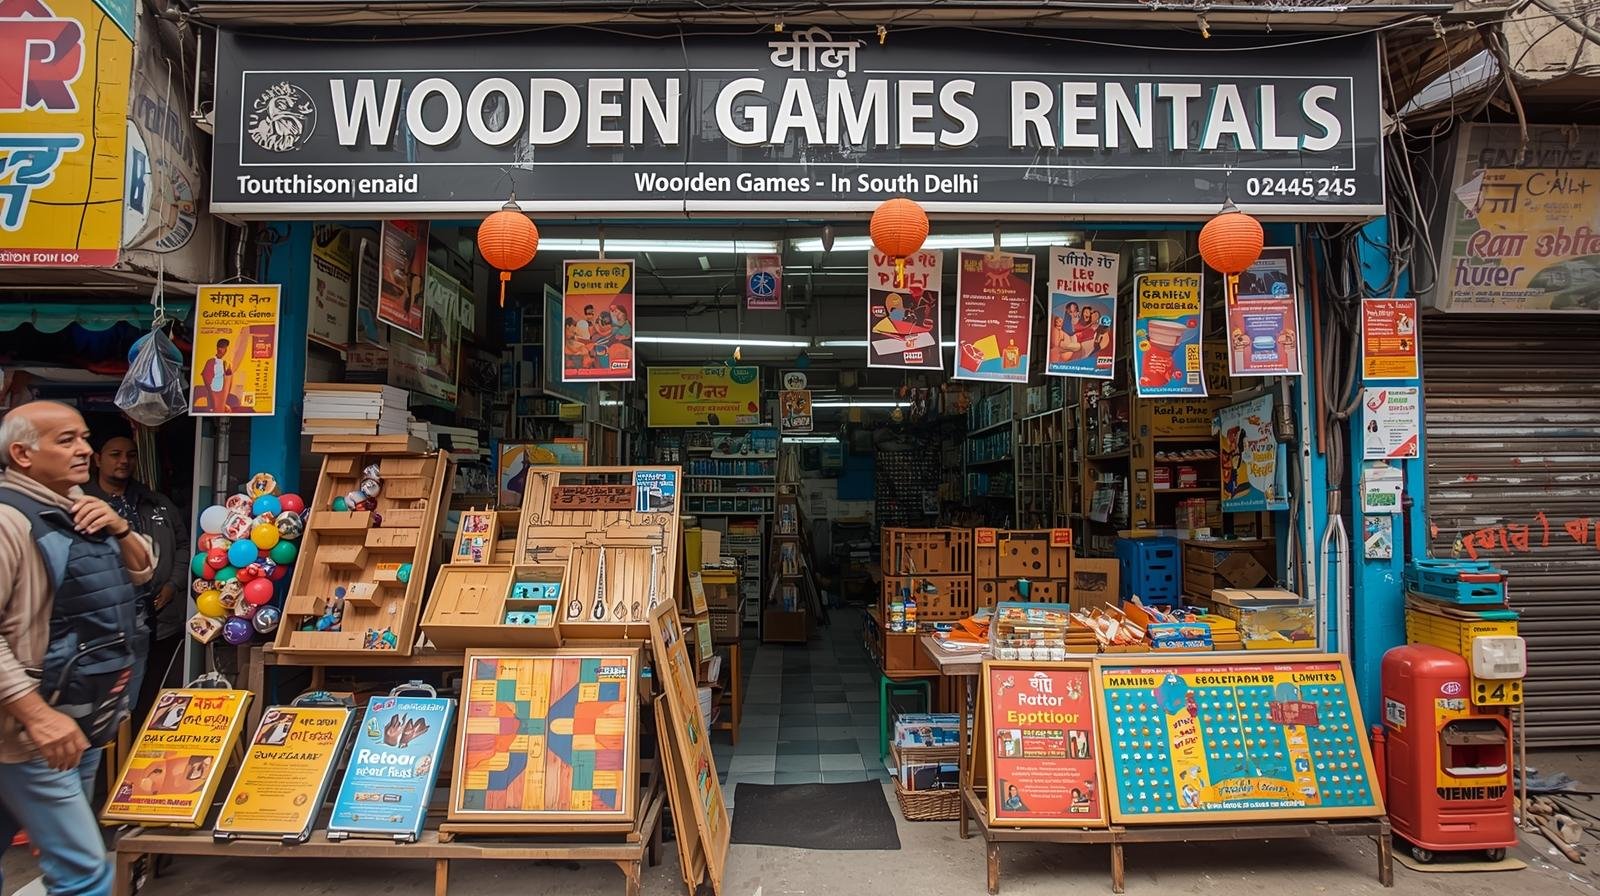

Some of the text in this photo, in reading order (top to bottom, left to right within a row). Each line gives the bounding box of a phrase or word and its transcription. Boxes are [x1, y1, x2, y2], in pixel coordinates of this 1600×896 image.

[329, 78, 680, 146] WOODEN
[715, 77, 978, 147] GAMES
[1010, 80, 1342, 152] RENTALS
[737, 173, 810, 192] Games
[832, 174, 851, 193] In
[858, 174, 919, 193] South
[926, 174, 979, 194] Delhi
